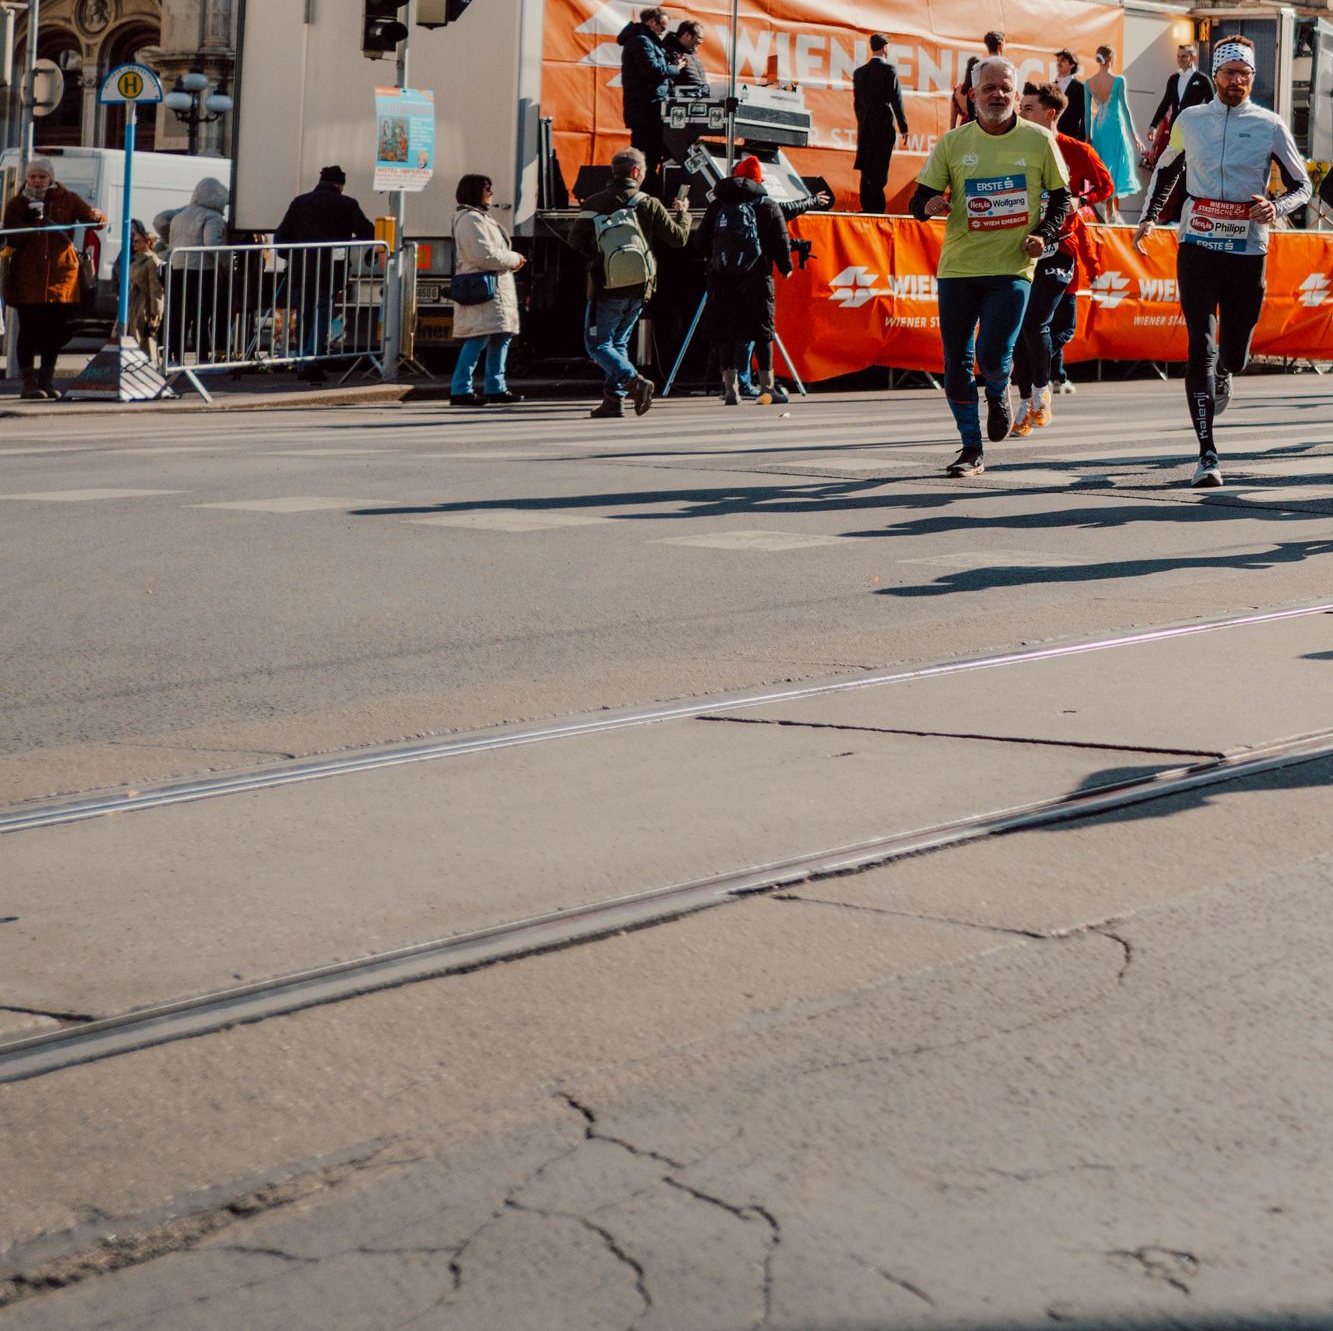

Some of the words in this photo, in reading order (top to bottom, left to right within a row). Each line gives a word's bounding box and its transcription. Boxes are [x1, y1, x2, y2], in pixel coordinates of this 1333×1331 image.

[715, 24, 868, 91] WIEN
[124, 76, 137, 94] H
[976, 181, 1004, 192] ERSTE
[993, 198, 1025, 209] Wolfgang
[1209, 200, 1235, 210] WIENER
[1214, 222, 1246, 235] Philipp
[1138, 278, 1180, 302] WIE
[884, 316, 927, 328] WIENER
[1133, 316, 1166, 326] WIENER
